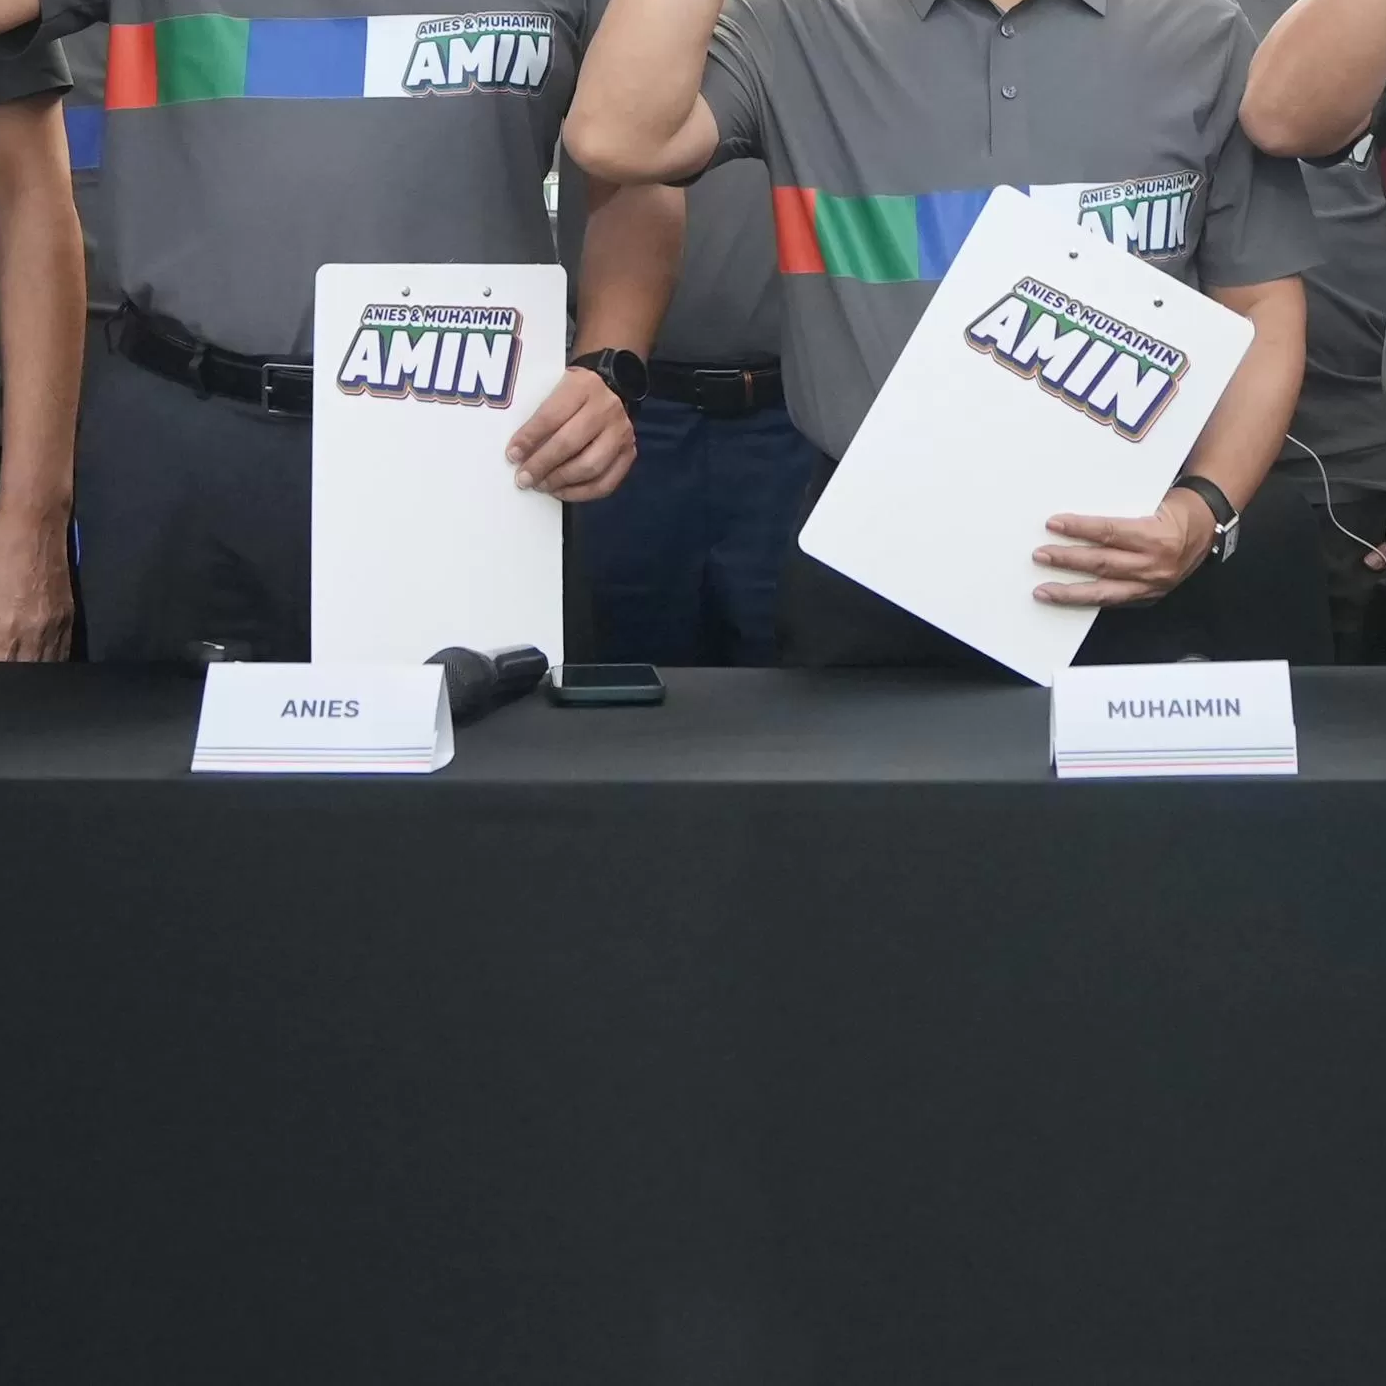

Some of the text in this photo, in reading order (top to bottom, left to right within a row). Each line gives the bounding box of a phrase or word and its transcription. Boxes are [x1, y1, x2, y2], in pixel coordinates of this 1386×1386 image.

[419, 16, 550, 35] ANIES & MUHAIMIN
[406, 34, 550, 87] AMIN
[1082, 174, 1198, 204] ANIES & MUHAIMIN
[364, 308, 513, 326] ANIES & MUHAIMIN
[1018, 280, 1180, 366] ANIES & MUHAIMIN
[340, 329, 513, 396] AMIN
[970, 294, 1170, 428] AMIN
[281, 699, 360, 718] ANIES
[1107, 698, 1242, 719] MUHAIMIN
